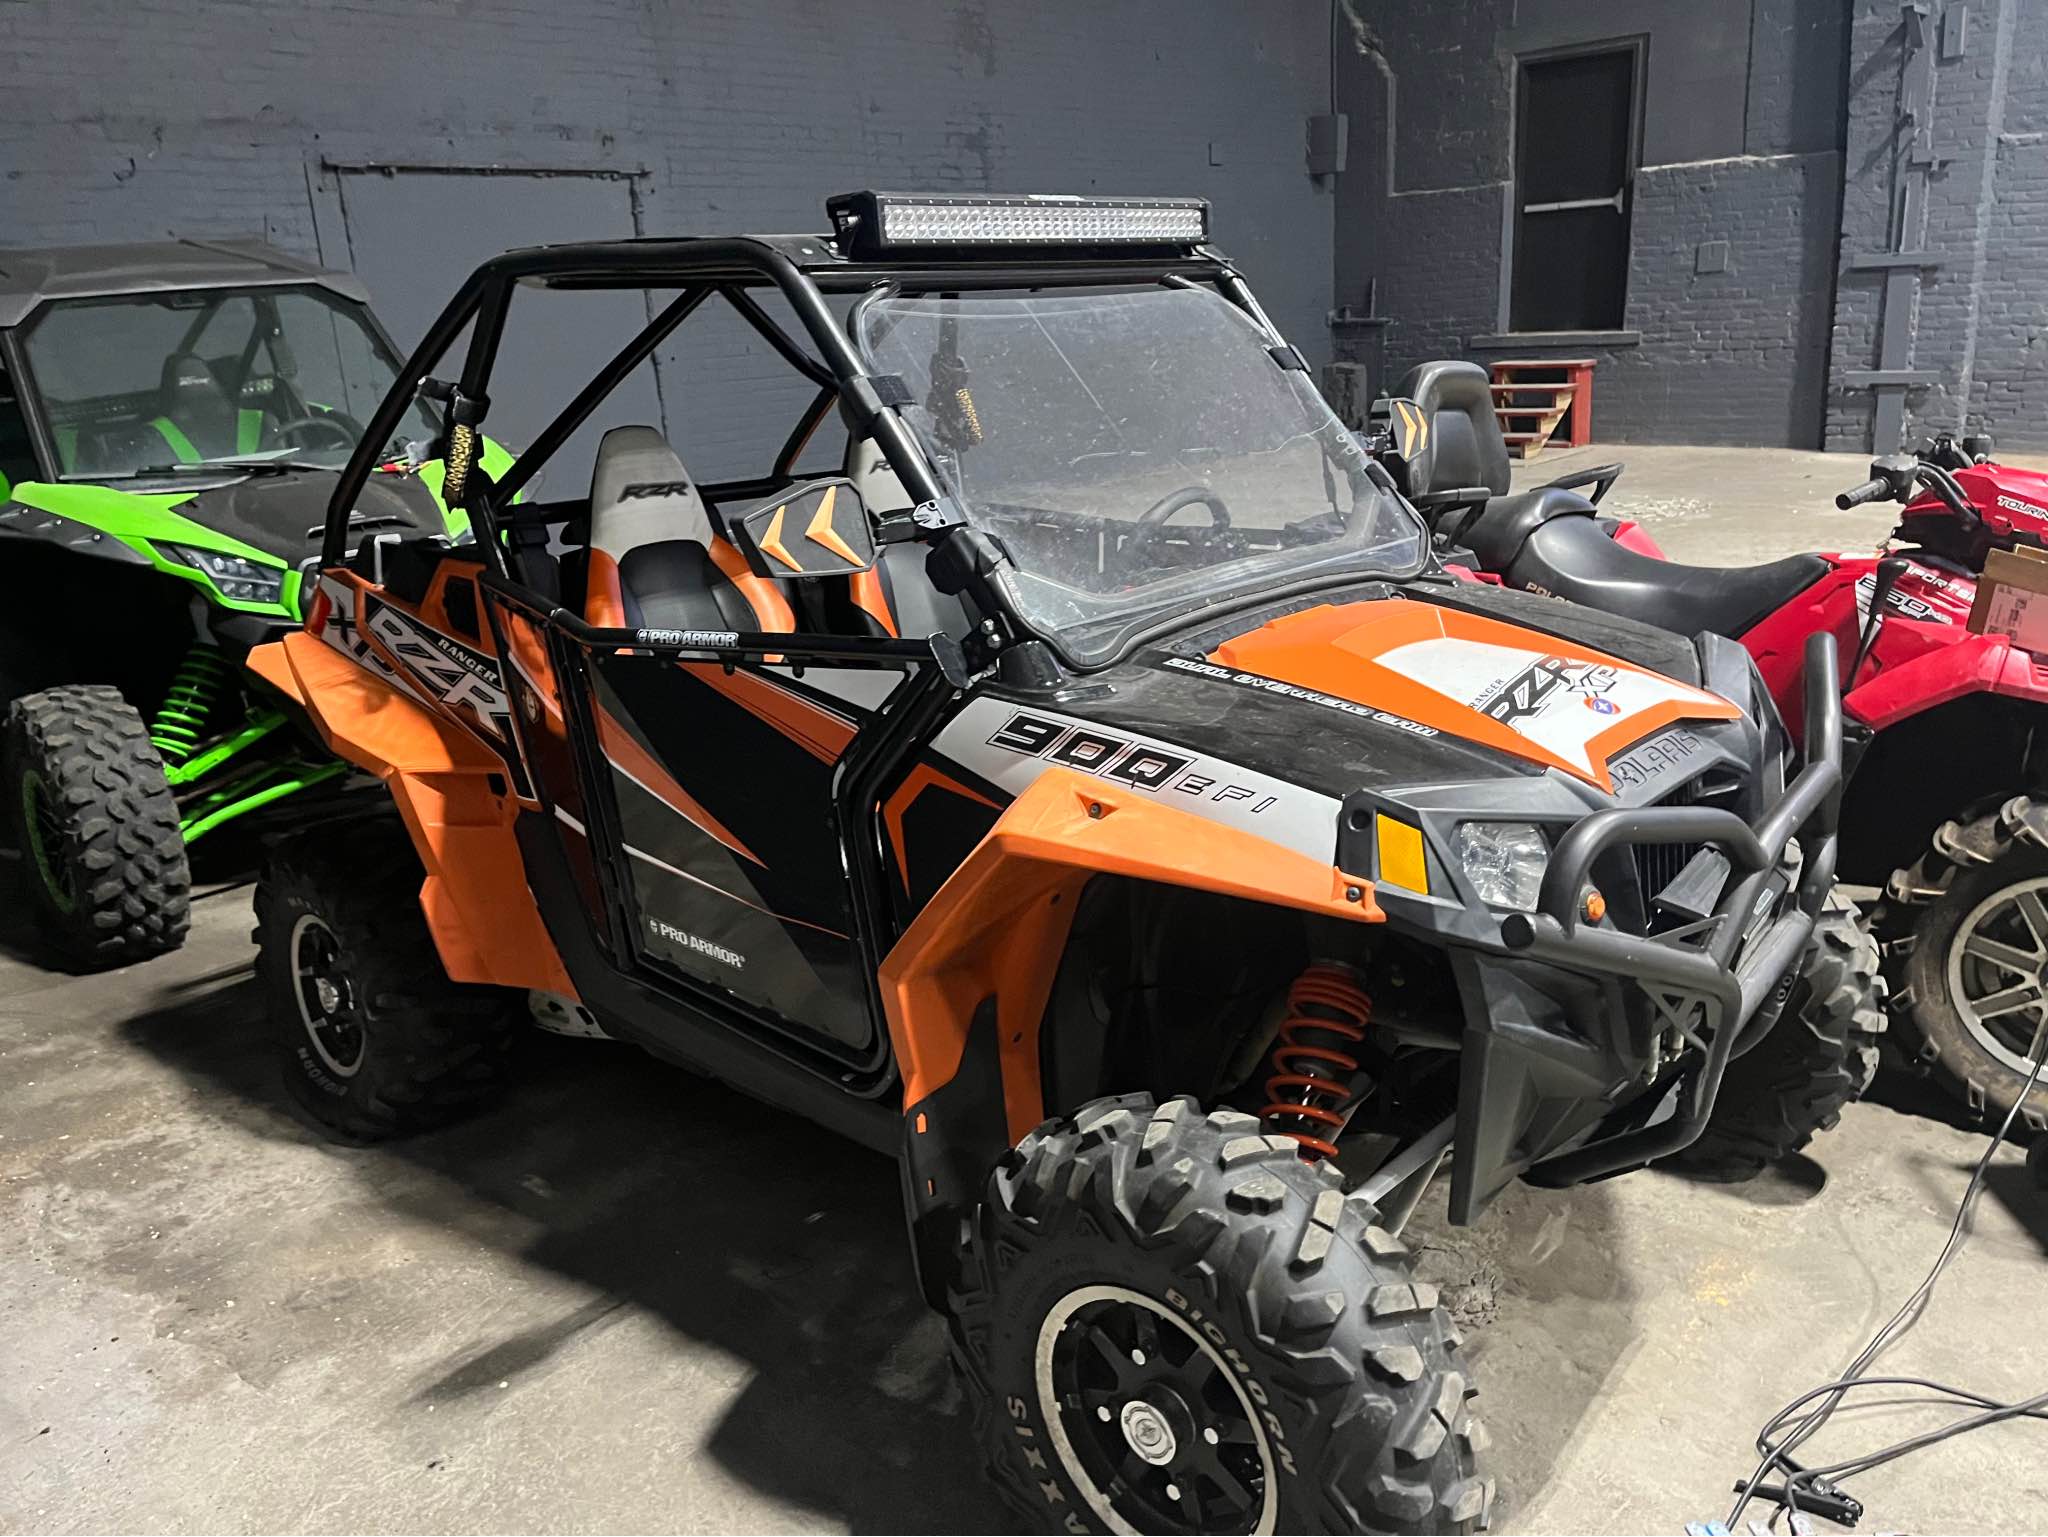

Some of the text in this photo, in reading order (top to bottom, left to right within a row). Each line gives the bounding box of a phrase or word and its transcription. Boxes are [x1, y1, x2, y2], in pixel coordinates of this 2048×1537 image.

[618, 482, 689, 503] RZR
[1997, 495, 2048, 523] TOURIN
[1906, 565, 1976, 602] PORTS
[437, 638, 499, 683] RANGER
[649, 630, 738, 648] PRO ARMOR
[367, 605, 511, 740] RZR
[1163, 657, 1232, 679] DUAL
[1233, 673, 1373, 716] OVERHEAD
[1469, 678, 1505, 710] RANGER
[1480, 655, 1618, 729] RZR XP
[986, 711, 1278, 814] 900 EFI
[659, 922, 743, 968] PRO ARMOR
[1165, 1287, 1298, 1477] BIGHORN
[1007, 1395, 1091, 1535] AXXIS
